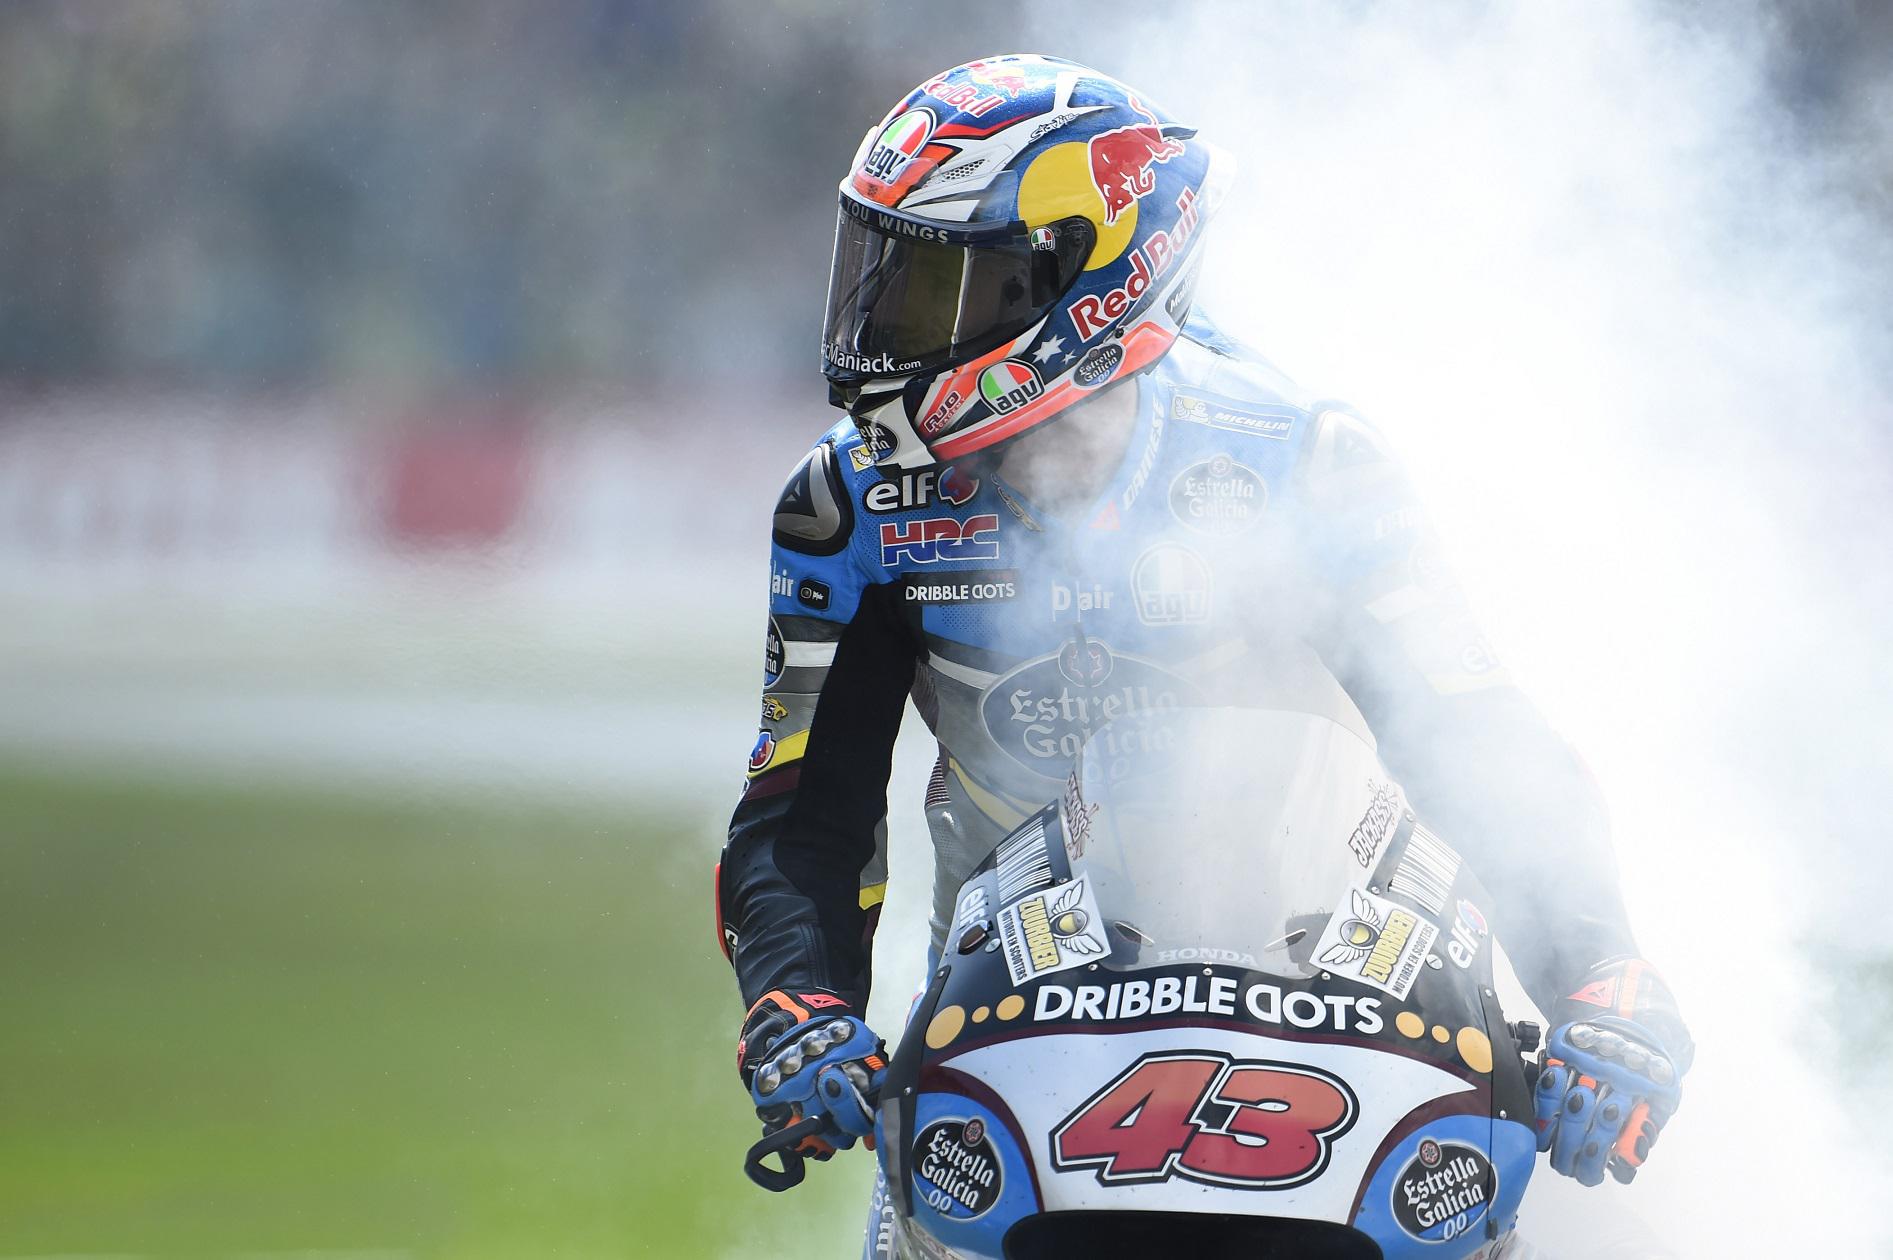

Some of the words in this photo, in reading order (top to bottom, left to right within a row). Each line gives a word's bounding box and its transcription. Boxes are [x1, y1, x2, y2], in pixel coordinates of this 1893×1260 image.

[867, 144, 906, 178] agv
[879, 214, 948, 244] WINGS
[1068, 249, 1152, 342] Red
[1143, 186, 1199, 279] Bull
[1079, 347, 1117, 376] Estrella
[1084, 356, 1118, 382] Galicia
[996, 380, 1038, 410] agv
[1214, 412, 1290, 431] MICHELIN
[1123, 392, 1164, 511] DAINESE
[866, 472, 935, 511] elf
[1183, 476, 1254, 498] Estrella
[1188, 498, 1249, 520] Galicia
[880, 514, 999, 567] HRC
[905, 584, 968, 601] DRIBBLE
[972, 582, 1015, 599] DOTS
[1010, 686, 1178, 725] Estrella
[1024, 722, 1176, 759] Galicia
[1348, 790, 1392, 868] JACKASS
[1158, 947, 1258, 964] HONDA
[1391, 961, 1415, 994] MOTOREN
[1413, 924, 1435, 955] SCOOTERS
[1447, 913, 1479, 969] elf
[1010, 945, 1028, 981] SCOOTERS
[1034, 976, 1238, 1021] DRIBBLE
[1246, 984, 1385, 1034] DOTS
[1049, 1049, 1360, 1191] 43
[928, 1128, 995, 1188] Estrella
[921, 1153, 980, 1209] Galicia
[1403, 1156, 1480, 1206] Estrella
[1416, 1181, 1484, 1228] Galicia
